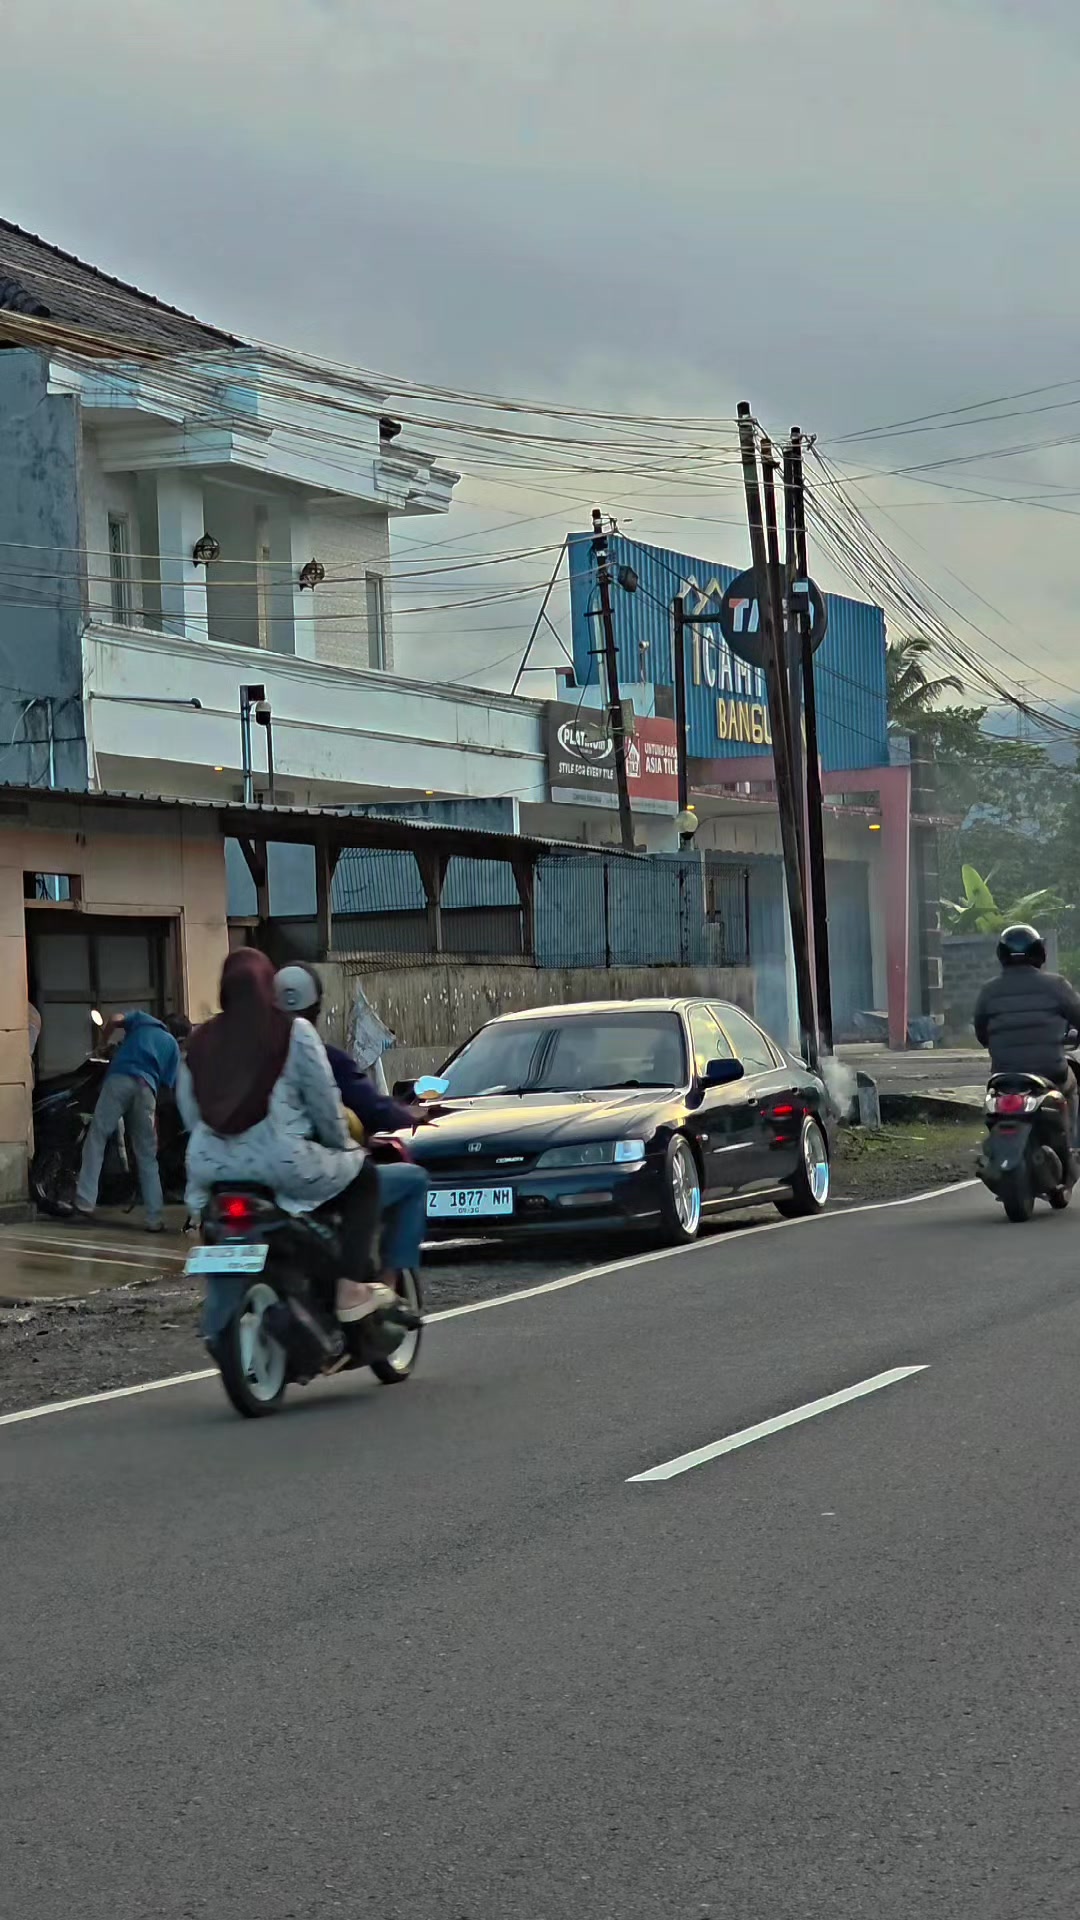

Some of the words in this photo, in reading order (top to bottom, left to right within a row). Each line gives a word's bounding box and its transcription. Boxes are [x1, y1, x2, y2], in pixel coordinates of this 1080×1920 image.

[559, 762, 574, 774] STYLE
[575, 764, 585, 775] FOR
[587, 766, 602, 778] EVERY
[603, 768, 614, 780] TILE
[645, 756, 662, 773] ASIA
[429, 1192, 437, 1208] Z
[450, 1190, 483, 1207] 1877
[492, 1189, 510, 1206] NH
